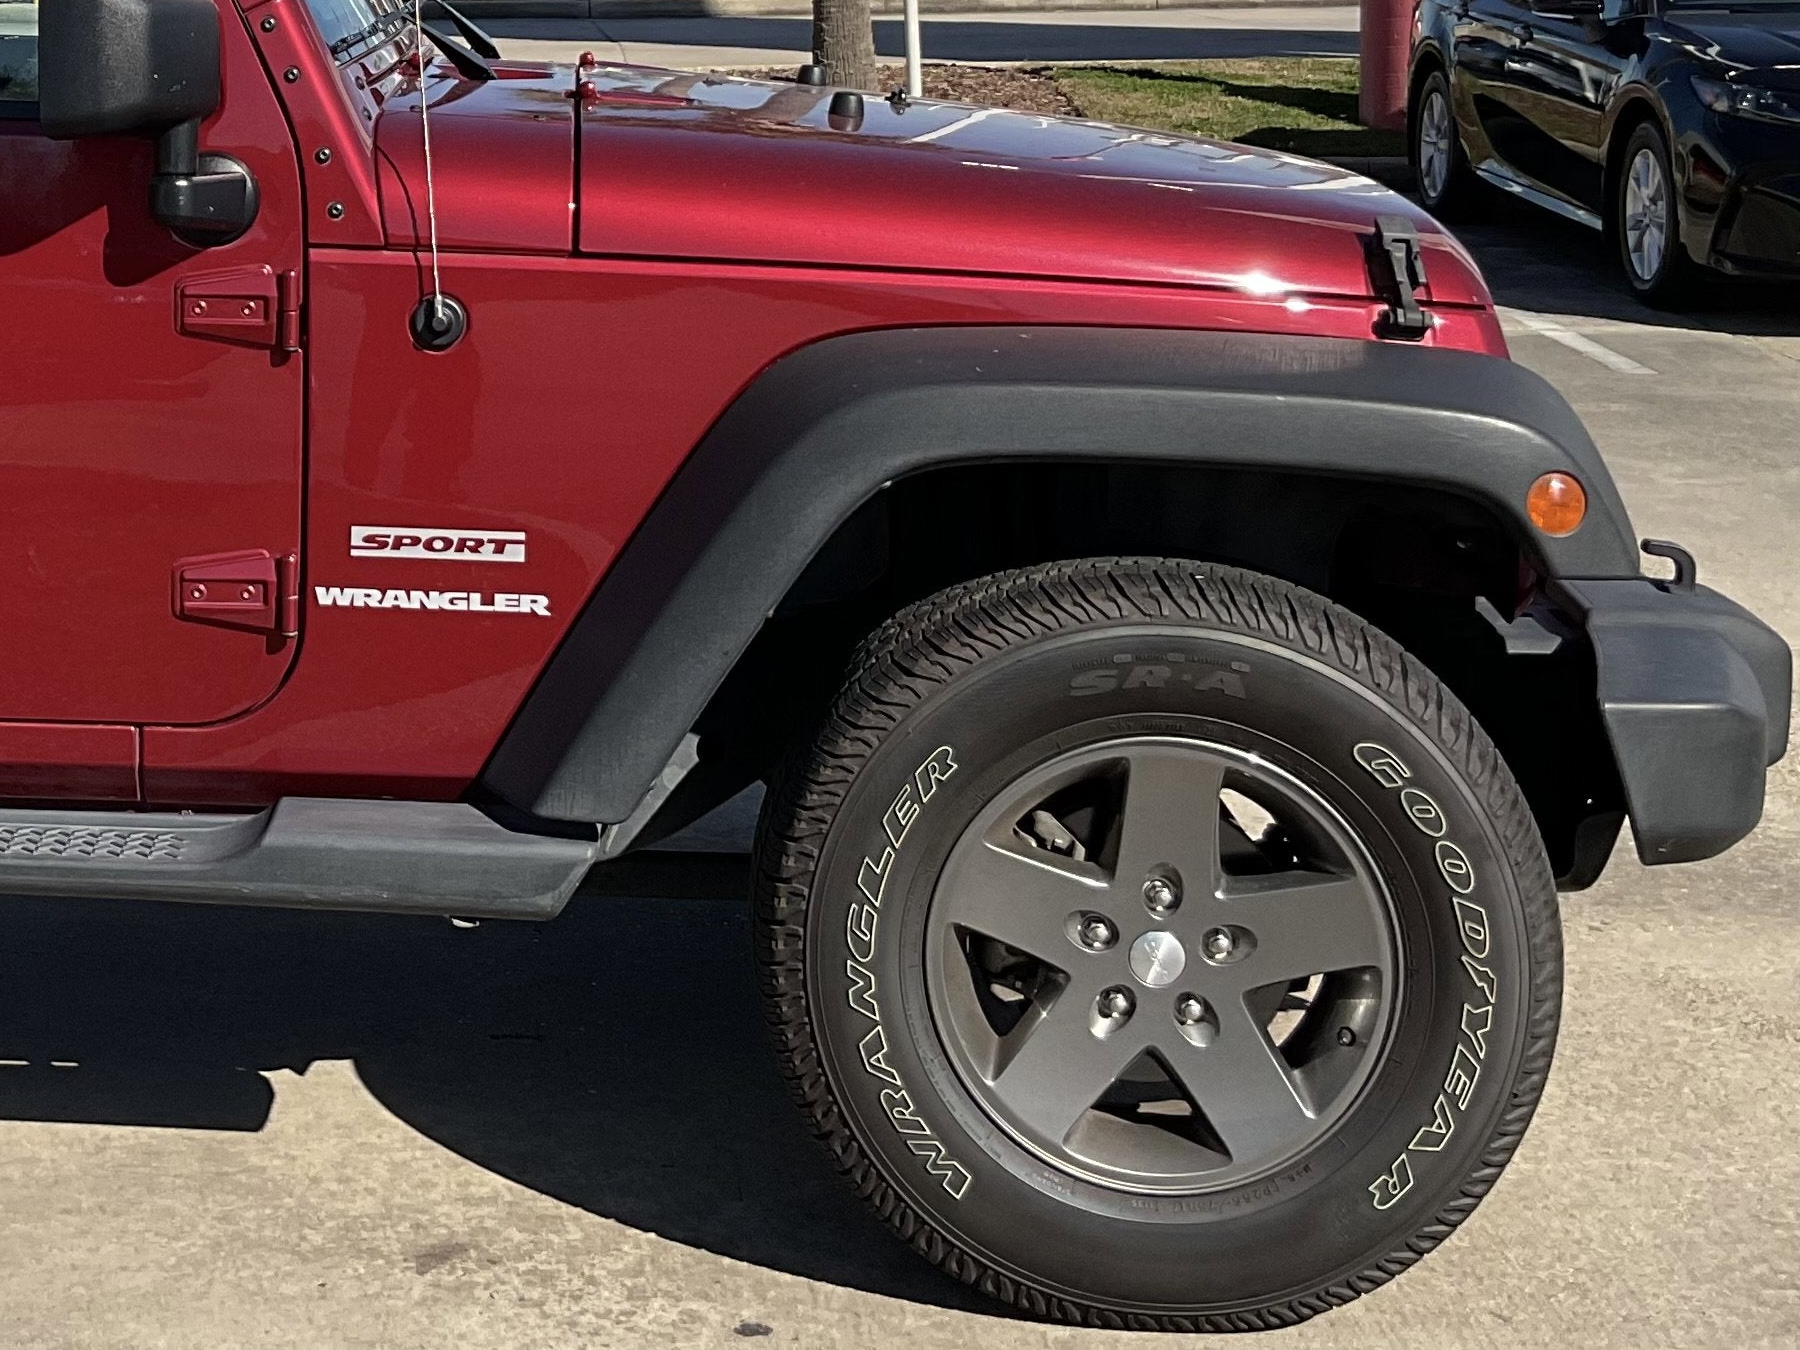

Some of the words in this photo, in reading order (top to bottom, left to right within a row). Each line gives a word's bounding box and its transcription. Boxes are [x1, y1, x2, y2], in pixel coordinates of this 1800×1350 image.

[314, 586, 551, 617] WRANGLER
[351, 532, 526, 556] SPORT
[846, 746, 972, 1202] WRANGLER
[1353, 742, 1497, 1211] GOODYEAR
